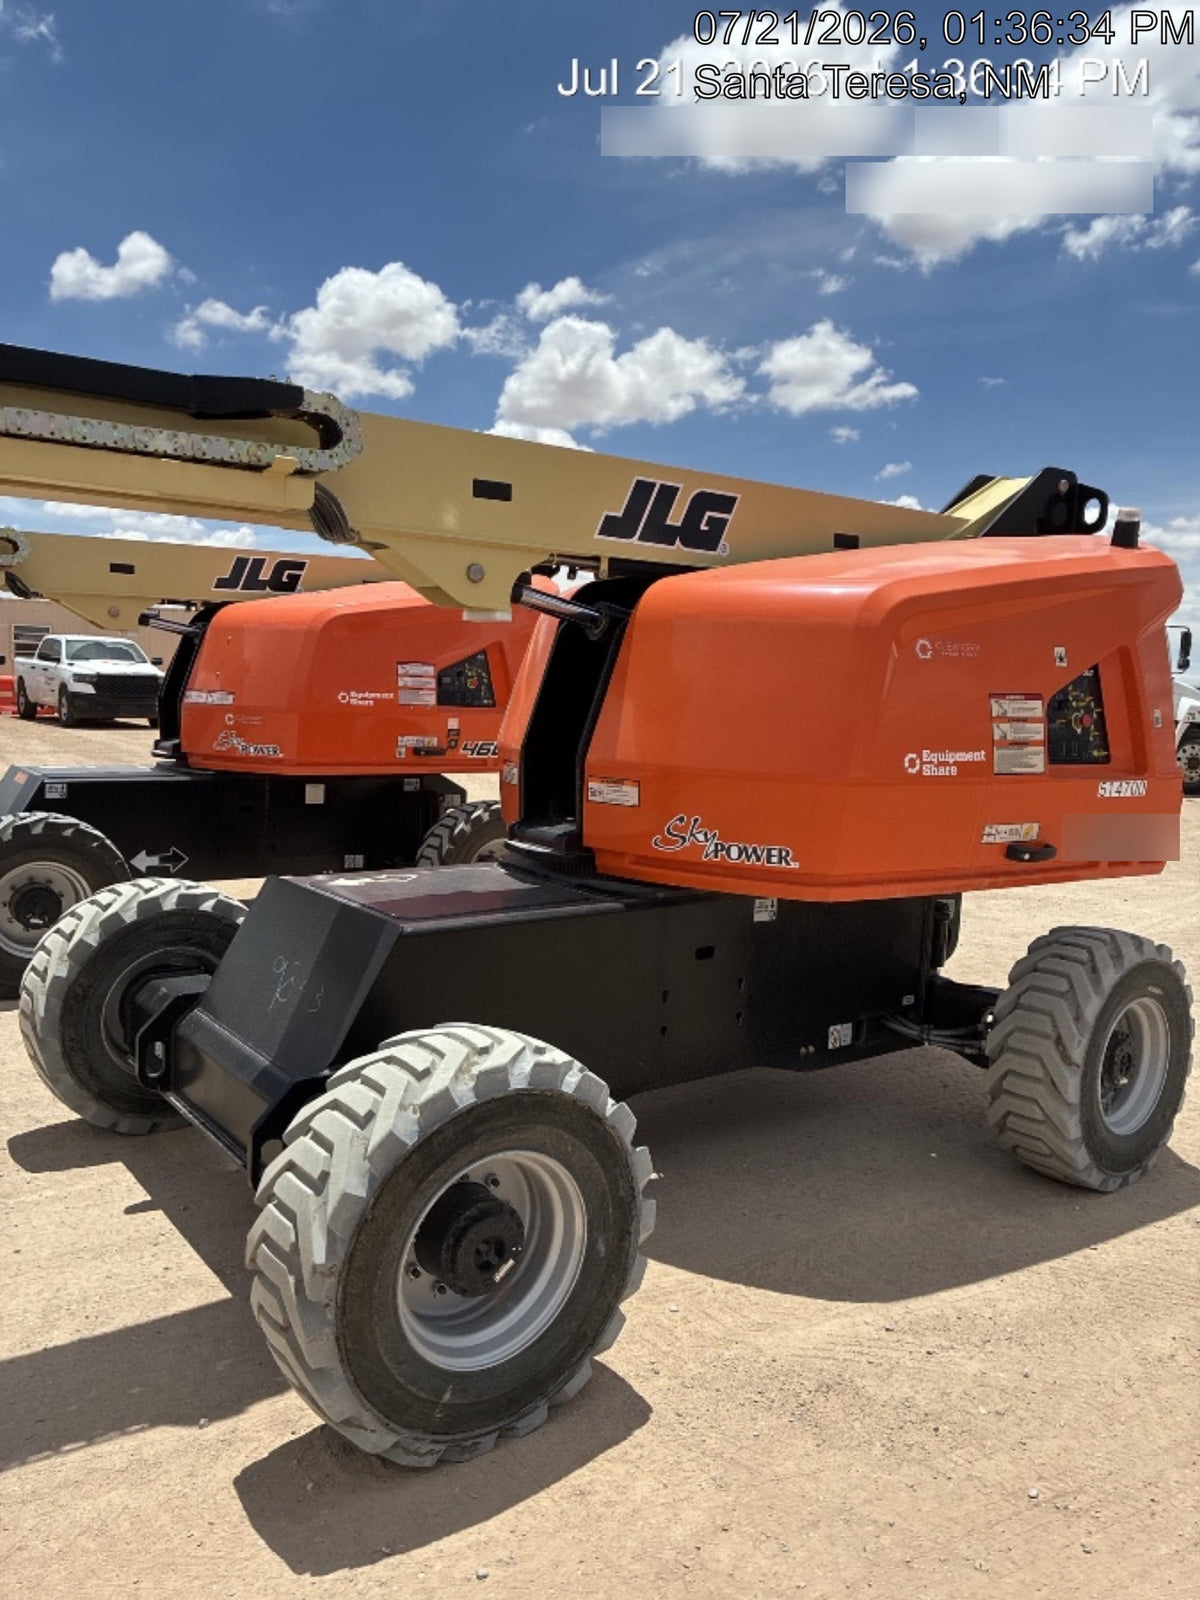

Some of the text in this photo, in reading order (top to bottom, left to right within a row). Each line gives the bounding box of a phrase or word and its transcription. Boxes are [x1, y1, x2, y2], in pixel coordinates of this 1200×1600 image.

[595, 476, 741, 556] JLG
[212, 556, 308, 594] JLG
[922, 749, 986, 764] Equipment
[922, 764, 958, 776] Share
[711, 841, 793, 867] POWER
